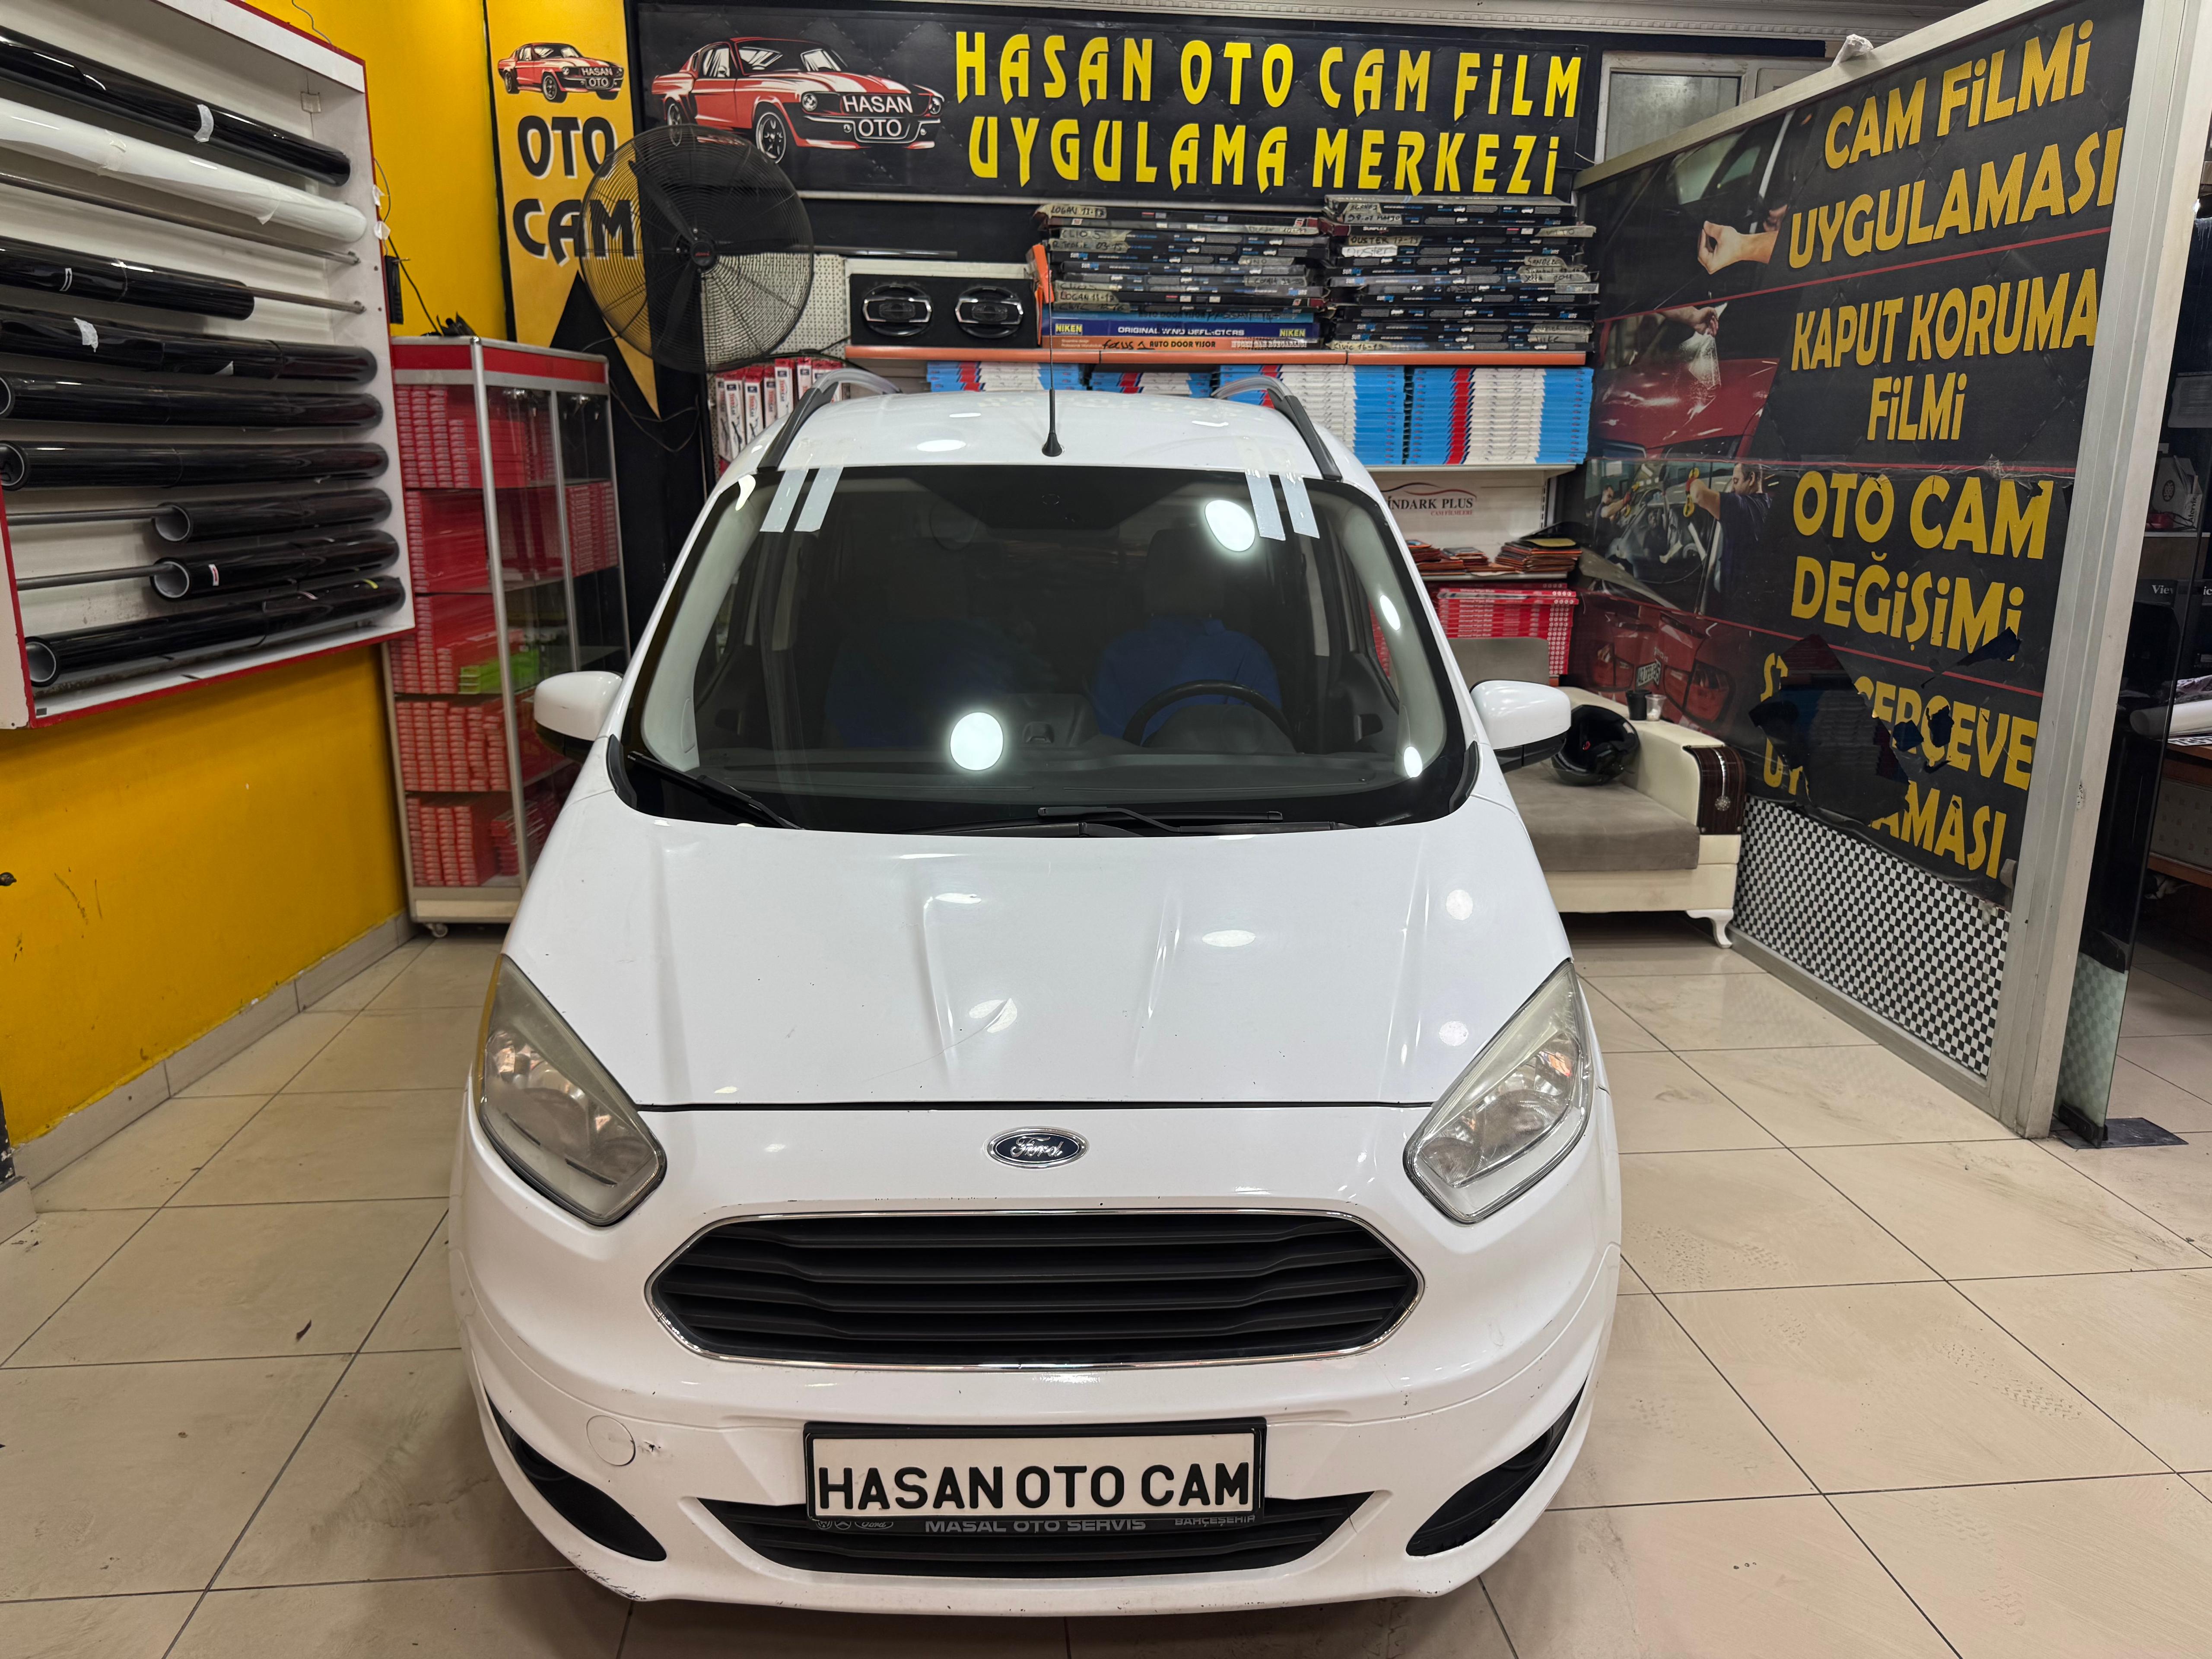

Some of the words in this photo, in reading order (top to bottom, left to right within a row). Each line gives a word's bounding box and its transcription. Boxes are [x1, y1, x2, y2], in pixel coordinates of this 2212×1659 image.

[581, 67, 613, 77] HASAN
[588, 77, 608, 88] OTO
[956, 32, 1152, 107] HASAN
[1180, 40, 1293, 108] OTO
[1319, 47, 1431, 117] CAM
[842, 94, 913, 114] HASAN
[858, 119, 903, 137] OTO
[1825, 77, 1927, 169] CAM
[518, 116, 616, 178] OTO
[969, 117, 1288, 194] UYGULAMA
[1789, 128, 2123, 268] UYGULAMASI
[512, 198, 639, 267] CAM
[1056, 324, 1082, 333] NIKEN
[1279, 329, 1306, 337] NIKEN
[1791, 297, 1903, 371] KAPUT
[1907, 269, 2098, 361] KORUMA
[1442, 498, 1473, 509] PLUS
[1793, 471, 1894, 543] OTO
[1910, 477, 2053, 559] CAM
[1011, 1137, 1064, 1157] Ford
[819, 1466, 1003, 1510] HASAN
[1016, 1465, 1125, 1508] OTO
[1141, 1462, 1249, 1506] CAM
[925, 1521, 1006, 1532] MASAL
[1014, 1521, 1060, 1533] OTO
